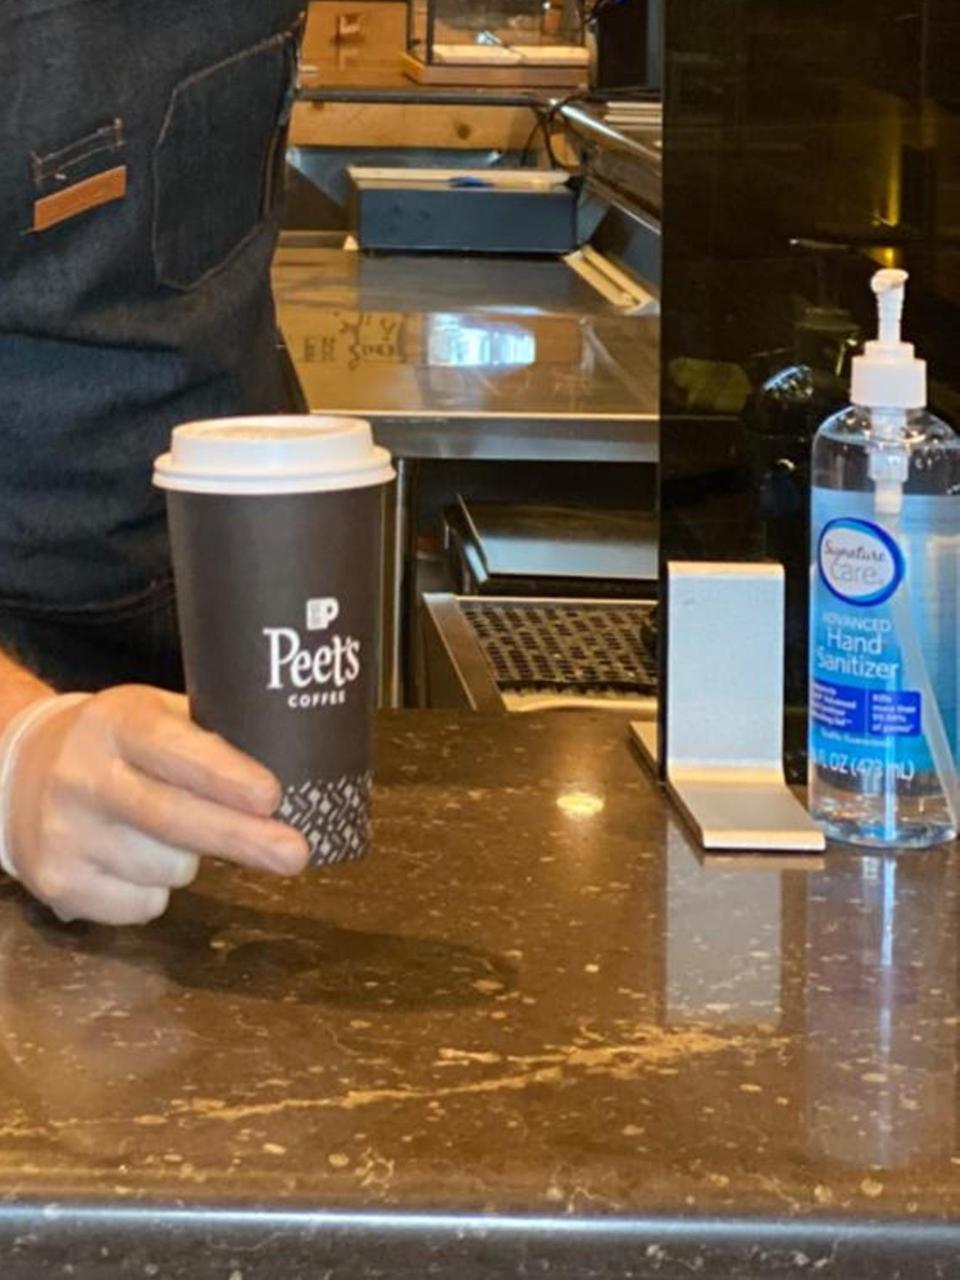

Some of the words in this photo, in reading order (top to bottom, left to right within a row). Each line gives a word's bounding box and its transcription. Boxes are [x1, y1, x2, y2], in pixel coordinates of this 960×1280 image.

[827, 626, 883, 655] Hand
[262, 626, 360, 690] Peet's
[815, 645, 899, 679] Sanitizer
[287, 690, 346, 708] COFFEE
[828, 752, 848, 774] OZ
